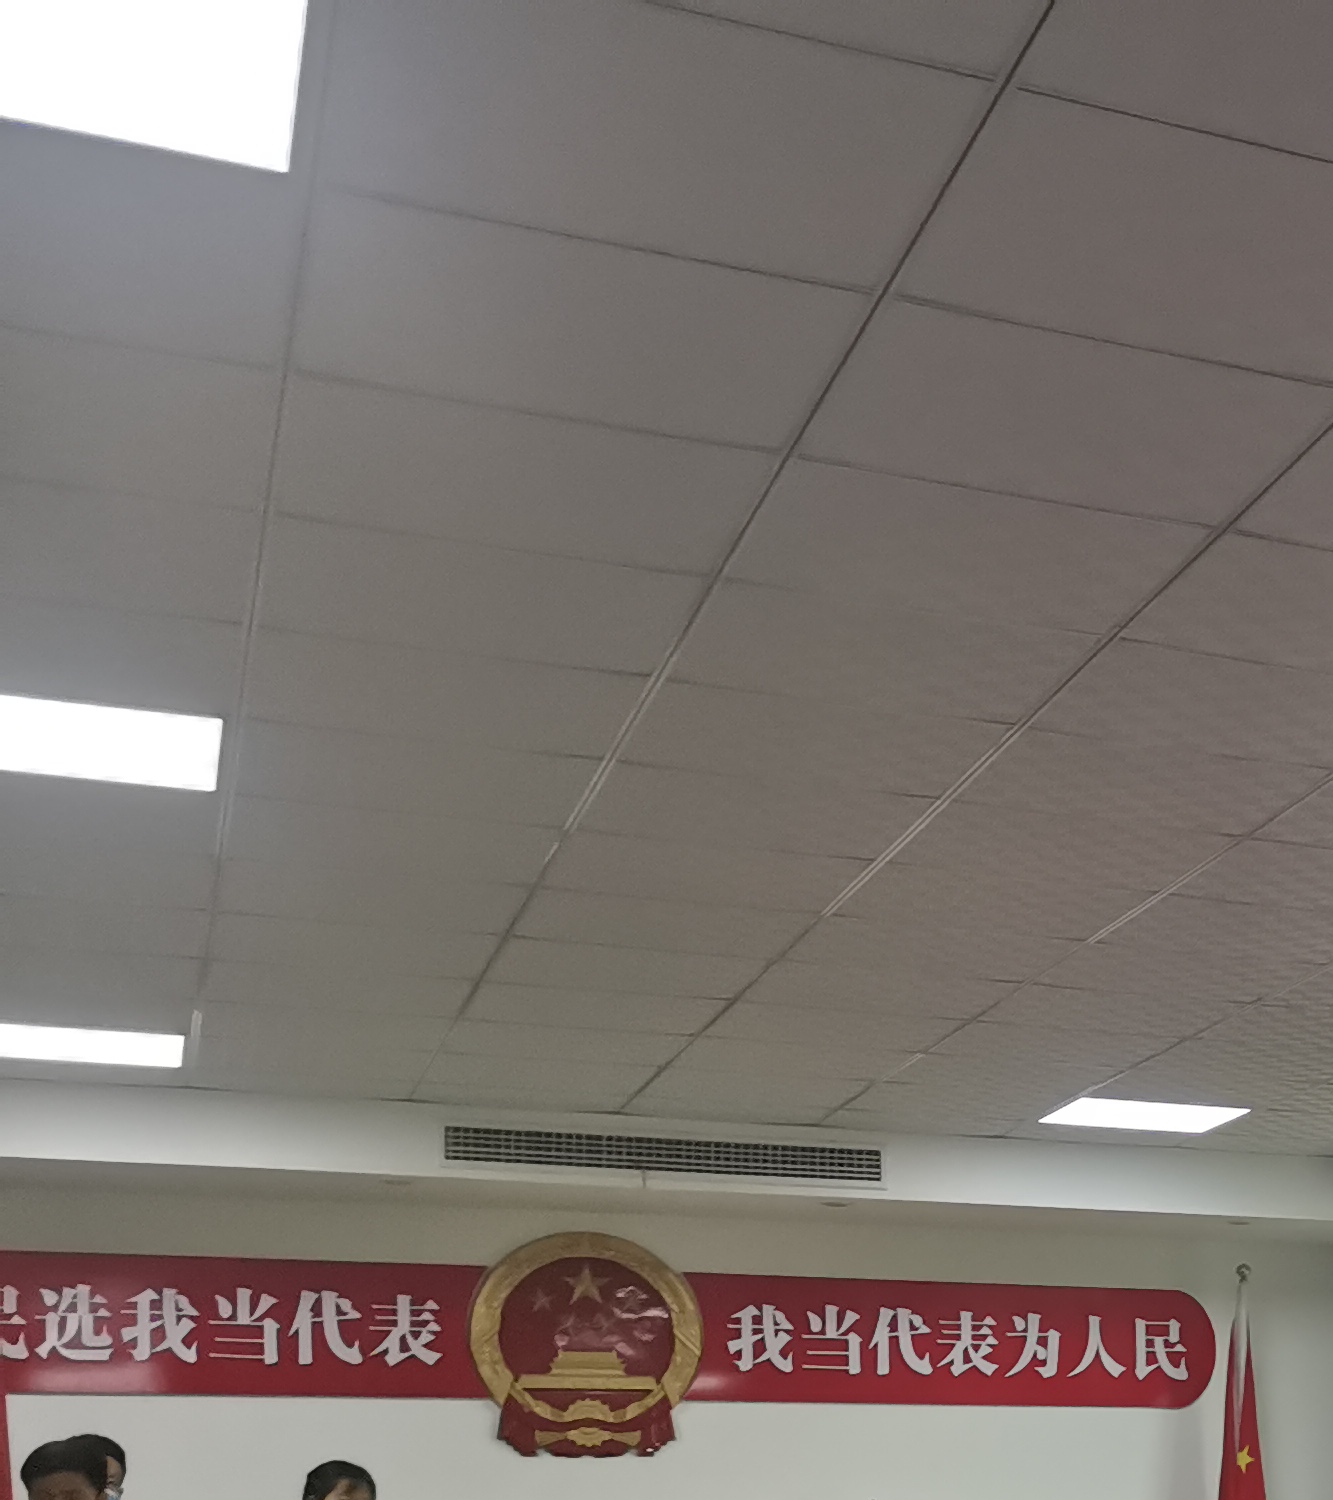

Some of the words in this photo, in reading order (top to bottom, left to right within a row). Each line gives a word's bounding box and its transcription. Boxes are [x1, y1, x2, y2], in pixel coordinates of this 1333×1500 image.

[726, 1302, 1190, 1381] 我当代表为人民
